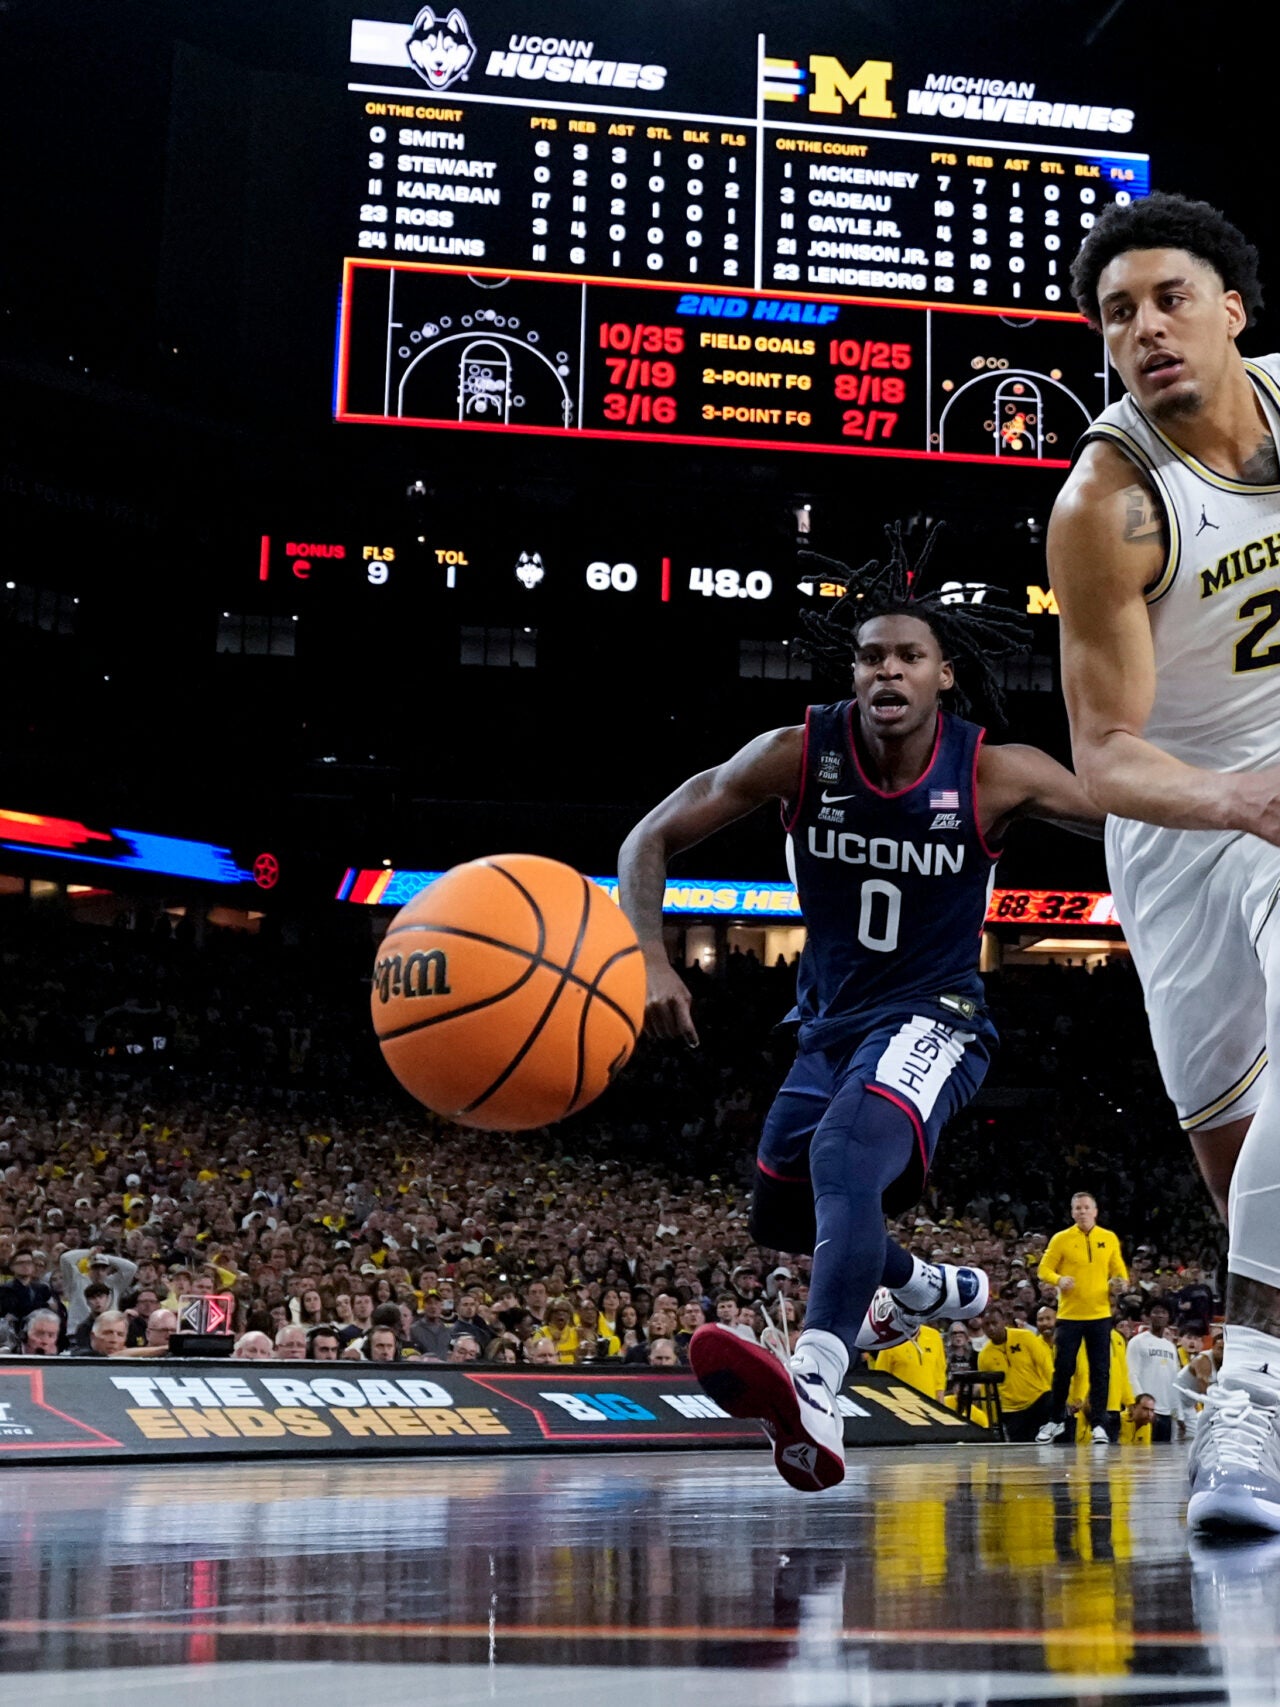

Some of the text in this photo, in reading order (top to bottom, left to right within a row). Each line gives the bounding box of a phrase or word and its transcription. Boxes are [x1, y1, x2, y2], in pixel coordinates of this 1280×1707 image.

[508, 34, 594, 58] UCONN
[485, 50, 668, 91] HUSKIES
[808, 54, 896, 119] M
[924, 72, 1035, 99] MICHIGAN
[365, 102, 746, 146] ON THE COURT PTS REB AST STL BLK FLS
[906, 88, 1136, 134] WOLVERINES
[370, 126, 386, 143] 0
[399, 129, 464, 150] SMITH
[573, 144, 588, 160] 3
[612, 147, 627, 163] 3
[654, 151, 661, 166] 1
[688, 154, 704, 170] 0
[729, 157, 736, 173] 1
[776, 138, 1134, 181] ON THE COURT PTS REB AST STL BLK FLS
[369, 152, 739, 199] 3 STEWART 0 2 0 0 0 2
[784, 163, 1131, 207] 1 MCKENNEY 7 7 1 0 0 0
[368, 179, 735, 224] 11 KARABAN 17 11 2 1 0 1
[780, 187, 795, 204] 3
[808, 190, 891, 212] CADEAU
[973, 203, 987, 220] 3
[1009, 206, 1023, 223] 2
[1045, 209, 1059, 226] 2
[1080, 212, 1095, 229] 0
[360, 204, 739, 250] 23 ROSS 3 4 0 0 0 2
[781, 213, 1060, 251] 11 GAYLE JR. 4 3 2 0
[358, 230, 387, 249] 24
[395, 233, 485, 256] MULLINS
[533, 244, 546, 261] 11
[613, 251, 620, 267] 1
[647, 253, 663, 270] 0
[690, 256, 697, 273] 1
[724, 259, 738, 276] 2
[777, 238, 1056, 275] 21 JOHNSON JR. 12 10 0 1
[773, 263, 1060, 301] 23 LENDEBORG 13 2 1 0
[676, 294, 840, 325] 2ND HALF
[600, 323, 911, 371] 10/35 FIELD GOALS 10/25
[606, 358, 905, 405] 7/19 2-POINT FG 8/18
[604, 393, 898, 441] 3/16 3-POINT FG 2/7
[286, 543, 468, 565] BONUS FLS TOL
[367, 561, 388, 584] 9
[447, 566, 455, 588] 1
[586, 562, 637, 591] 60
[689, 568, 772, 599] 48.0
[1026, 585, 1059, 614] M
[819, 770, 838, 780] FOUR
[820, 756, 840, 765] FINAL
[931, 820, 962, 828] EAST
[808, 826, 964, 876] UCONN
[858, 879, 901, 952] 0
[997, 895, 1030, 918] 68
[1038, 895, 1089, 920] 32
[110, 1377, 454, 1408] THE ROAD
[538, 1392, 657, 1421] BIG
[849, 1385, 967, 1426] M
[125, 1408, 511, 1439] ENDS HERE
